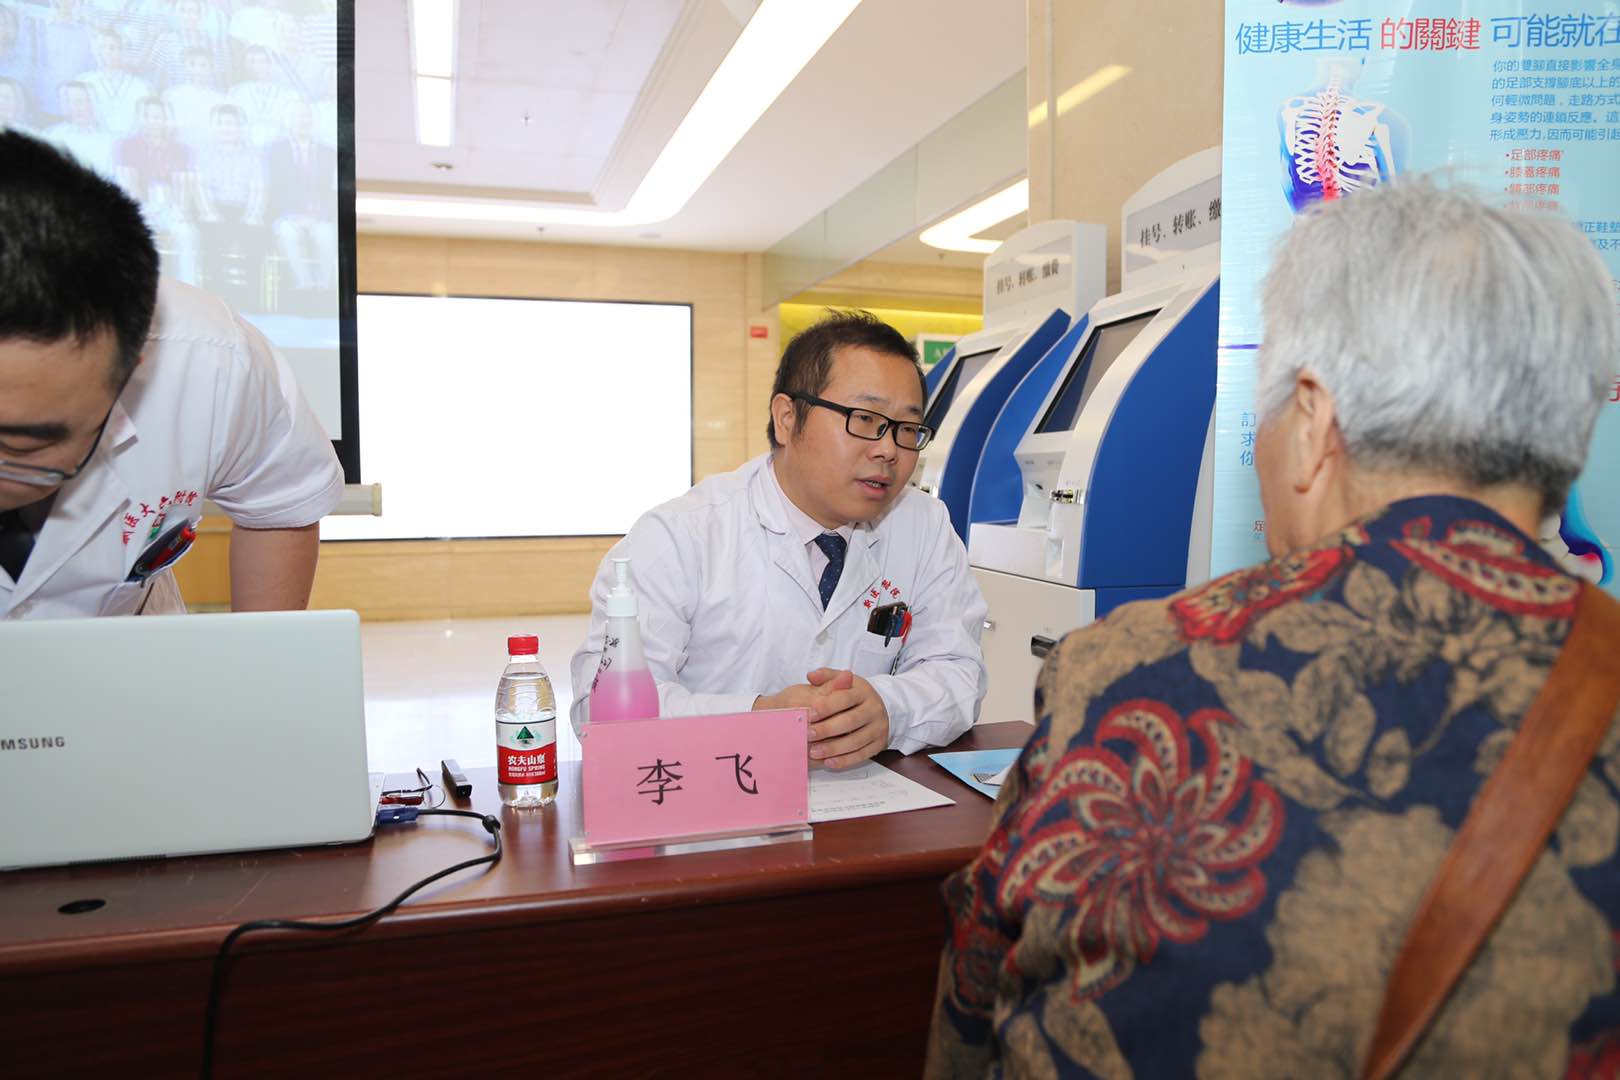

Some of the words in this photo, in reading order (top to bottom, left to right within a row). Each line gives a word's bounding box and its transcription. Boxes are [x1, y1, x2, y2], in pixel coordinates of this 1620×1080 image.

[1235, 18, 1373, 55] 健康生活
[1380, 16, 1480, 51] 的關鍵
[1490, 12, 1620, 49] 可能就在
[0, 736, 66, 751] MSUNG
[636, 758, 684, 806] 李
[715, 752, 759, 796] 飞
